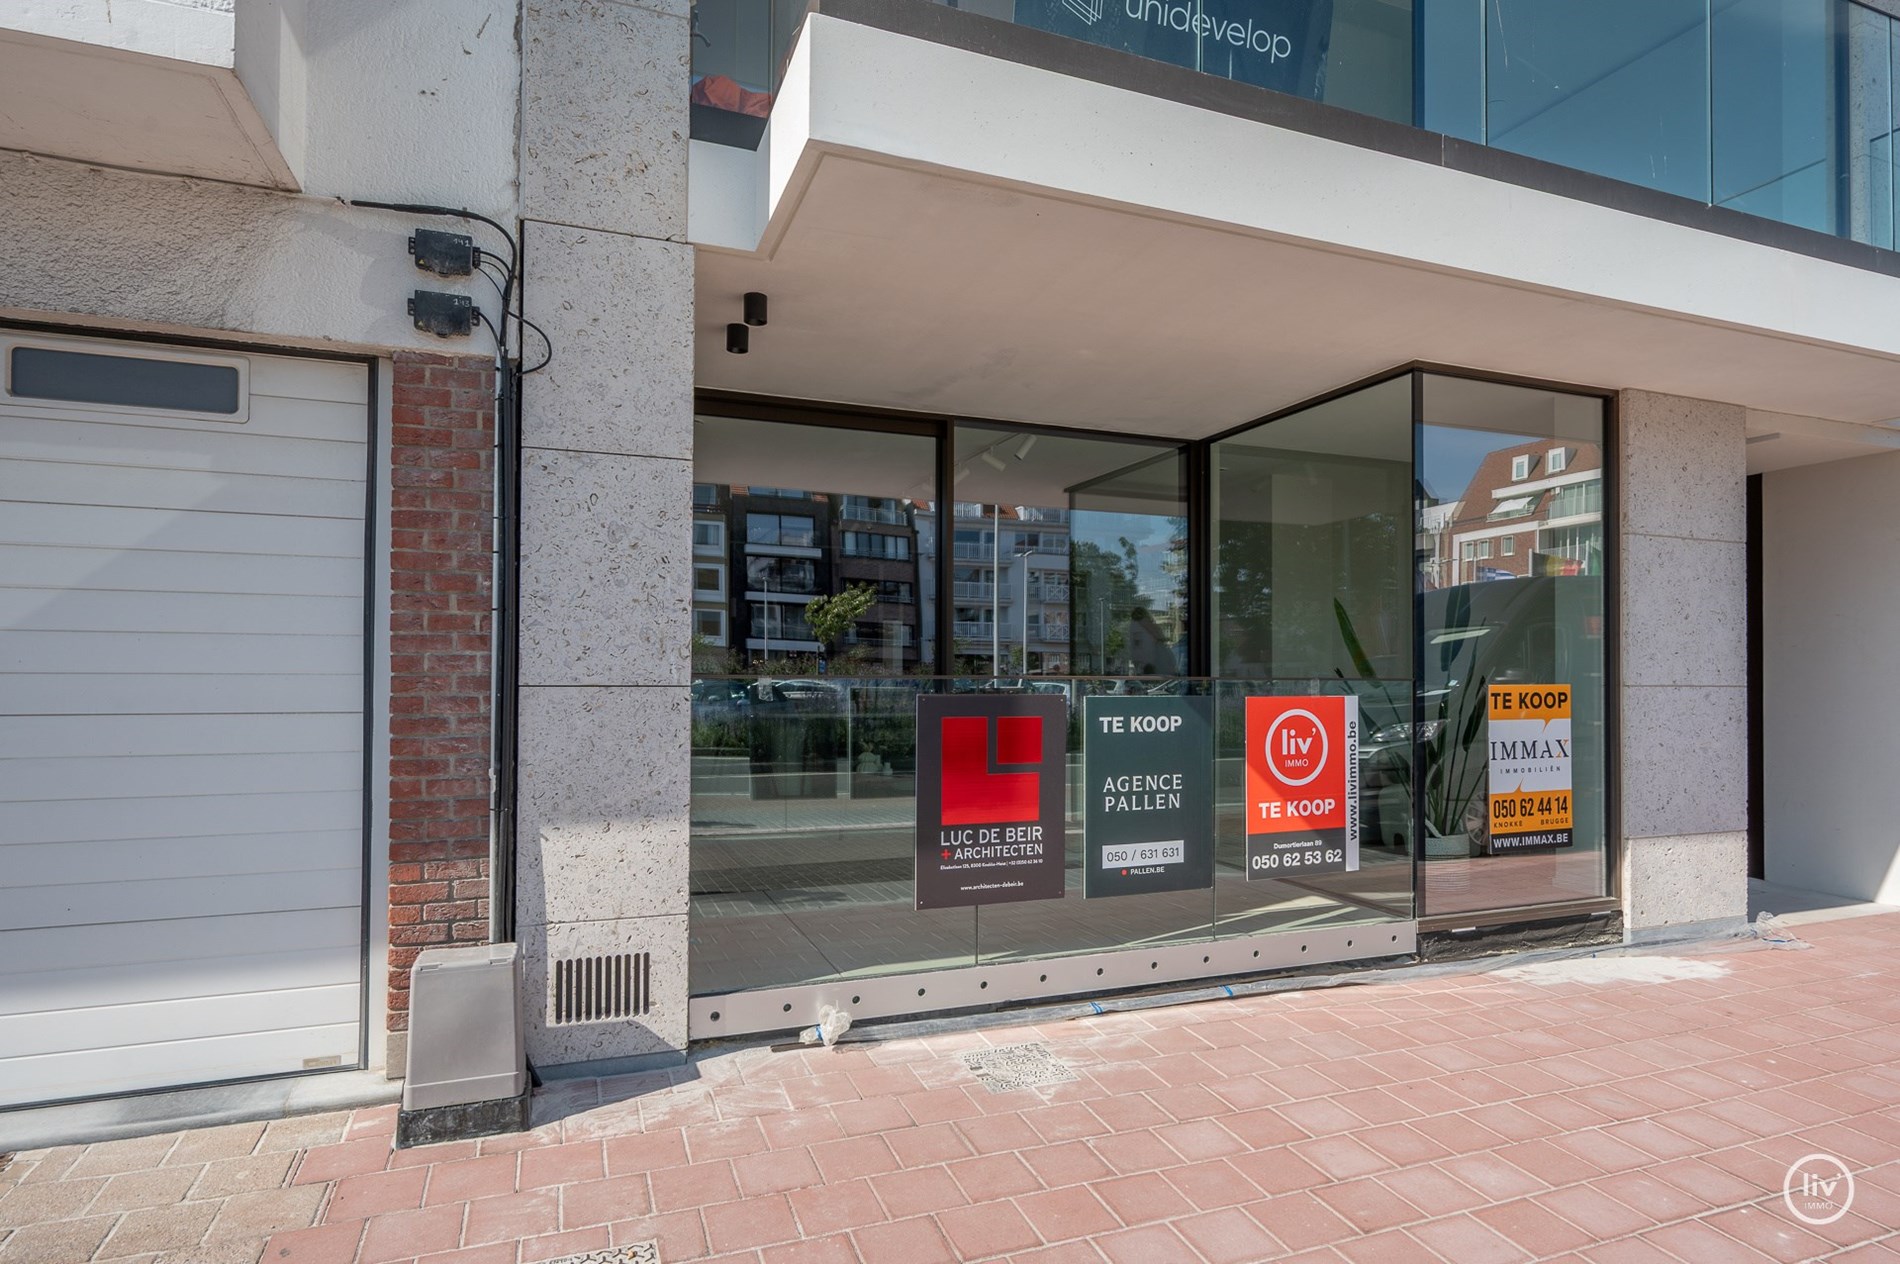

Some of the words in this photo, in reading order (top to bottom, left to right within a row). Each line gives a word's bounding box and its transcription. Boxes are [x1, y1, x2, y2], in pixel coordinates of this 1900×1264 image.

[1125, 0, 1291, 63] unidevelop
[1491, 692, 1512, 710] TE
[1518, 691, 1568, 709] KOOP
[1099, 716, 1125, 733] TE
[1130, 715, 1182, 733] KOOP
[1490, 739, 1569, 761] IMMAX
[1285, 758, 1309, 768] IMMO
[1500, 766, 1561, 775] IMMOBILIËN
[1103, 774, 1183, 793] AGENCE
[1347, 721, 1357, 841] www.livimmo.be
[1104, 793, 1181, 812] PALLEN
[1258, 801, 1282, 819] TE
[1286, 798, 1336, 818] KOOP
[1493, 798, 1516, 819] 050
[1520, 798, 1535, 817] 62
[1537, 796, 1552, 816] 44
[1554, 795, 1568, 815] 14
[1493, 820, 1523, 829] KNOKKE
[1540, 817, 1569, 826] BRUGGE
[940, 830, 973, 846] LUC
[979, 828, 1000, 844] DE
[1005, 826, 1043, 842] BEIR
[1273, 840, 1314, 849] Dumortierlaan
[1493, 832, 1569, 849] WWW.IMMAX.BE
[954, 843, 1043, 860] ARCHITECTEN
[1106, 850, 1128, 862] 050
[1140, 848, 1159, 860] 631
[1162, 847, 1180, 858] 631
[1252, 854, 1279, 870] 050
[1283, 852, 1301, 867] 62
[1304, 850, 1322, 865] 53
[1325, 848, 1343, 863] 62
[1130, 866, 1165, 876] PALLEN.BE
